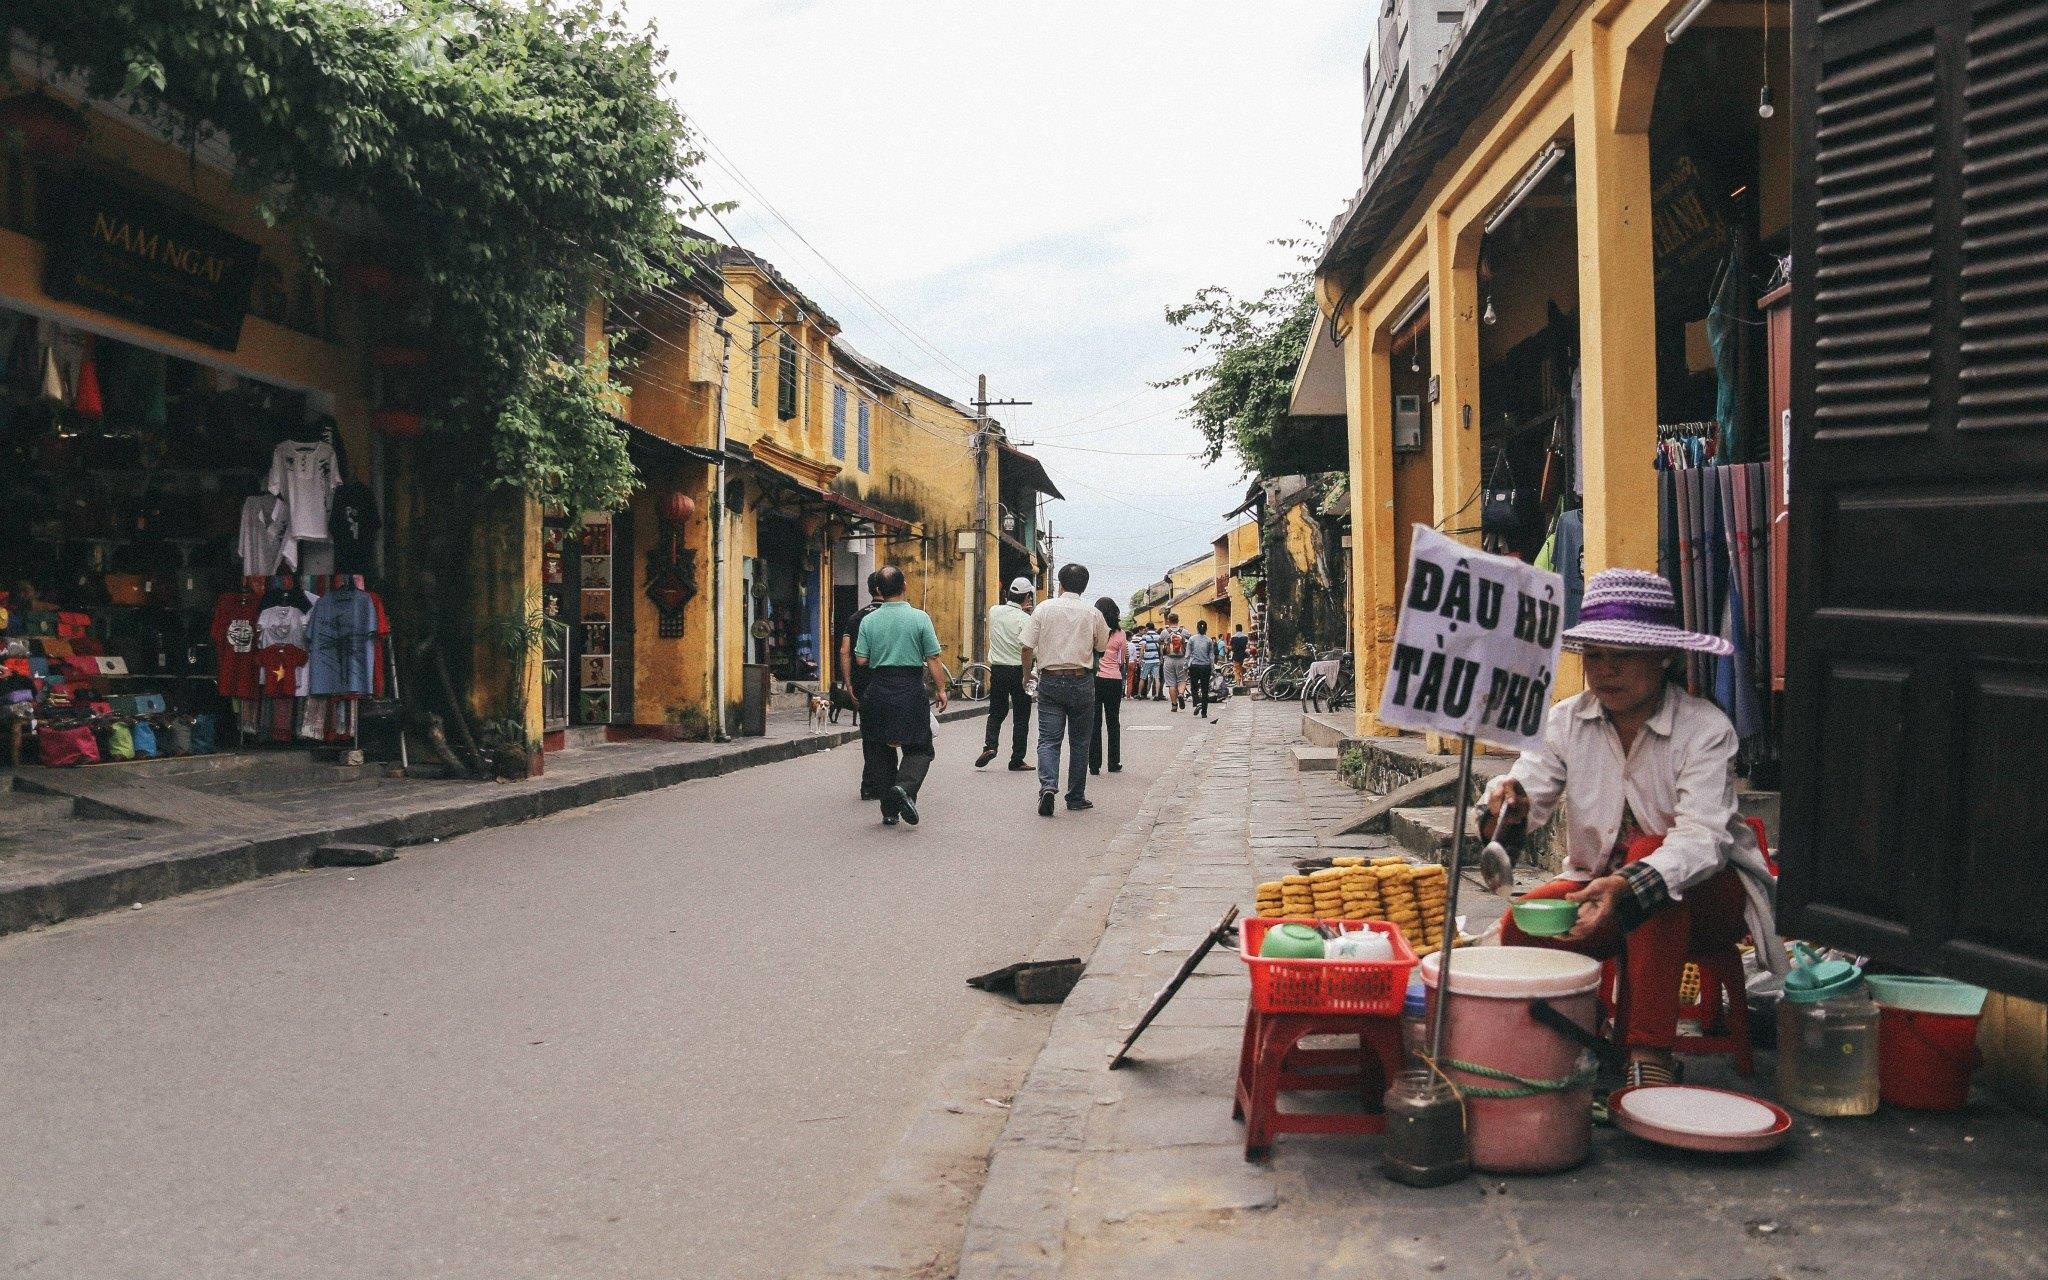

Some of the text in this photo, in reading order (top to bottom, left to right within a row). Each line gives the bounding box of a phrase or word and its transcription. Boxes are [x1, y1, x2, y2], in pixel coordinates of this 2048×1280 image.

[93, 211, 159, 260] NAM
[1407, 557, 1560, 649] ĐẬU HỦ
[1392, 633, 1552, 737] TÀU PHỚ
